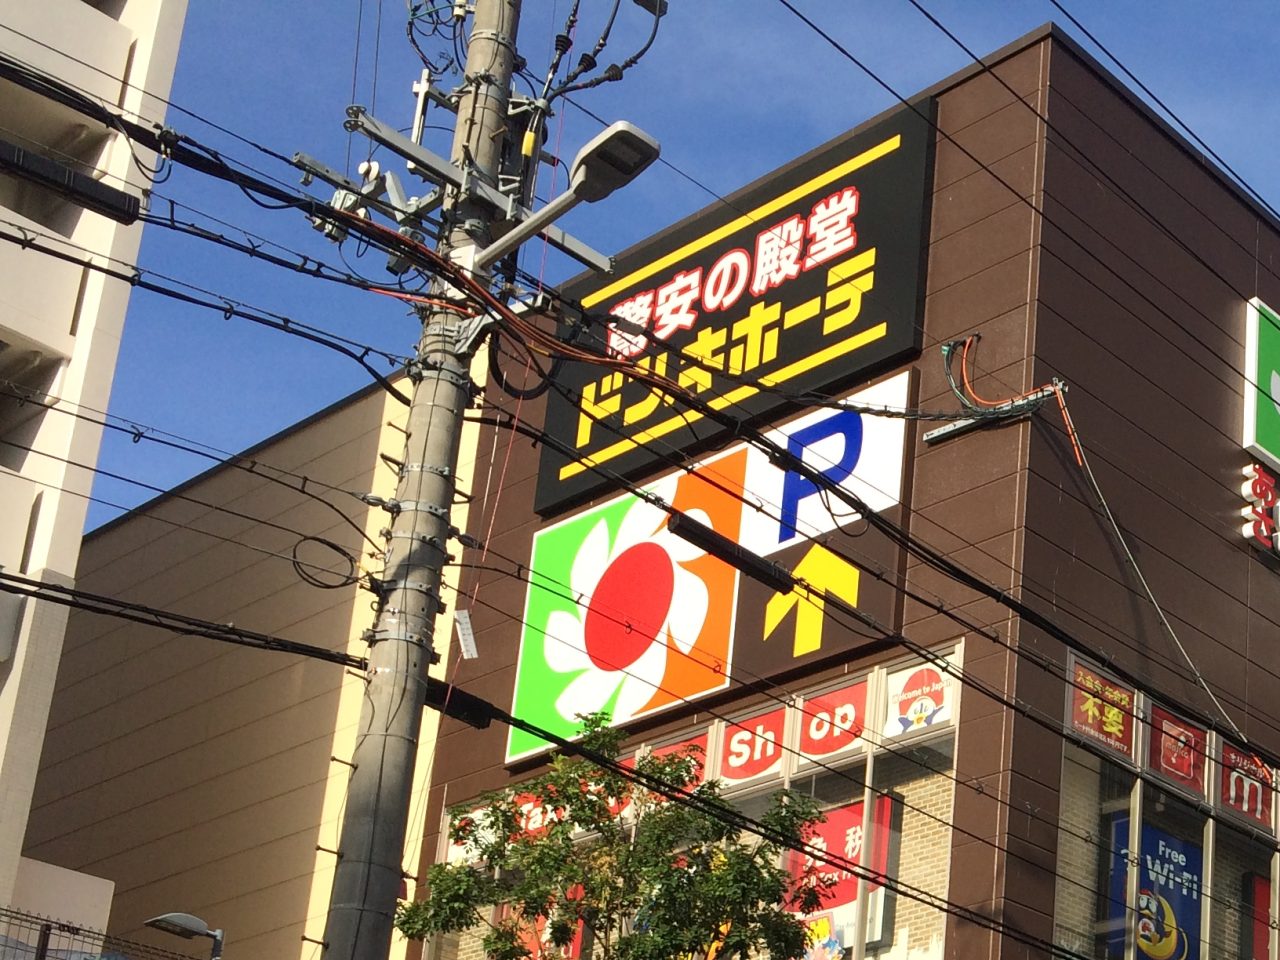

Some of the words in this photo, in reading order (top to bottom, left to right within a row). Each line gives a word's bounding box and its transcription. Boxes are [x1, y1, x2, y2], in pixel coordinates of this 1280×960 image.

[779, 410, 863, 544] P
[1159, 840, 1186, 866] Free
[1146, 854, 1198, 900] Wi-Fi
